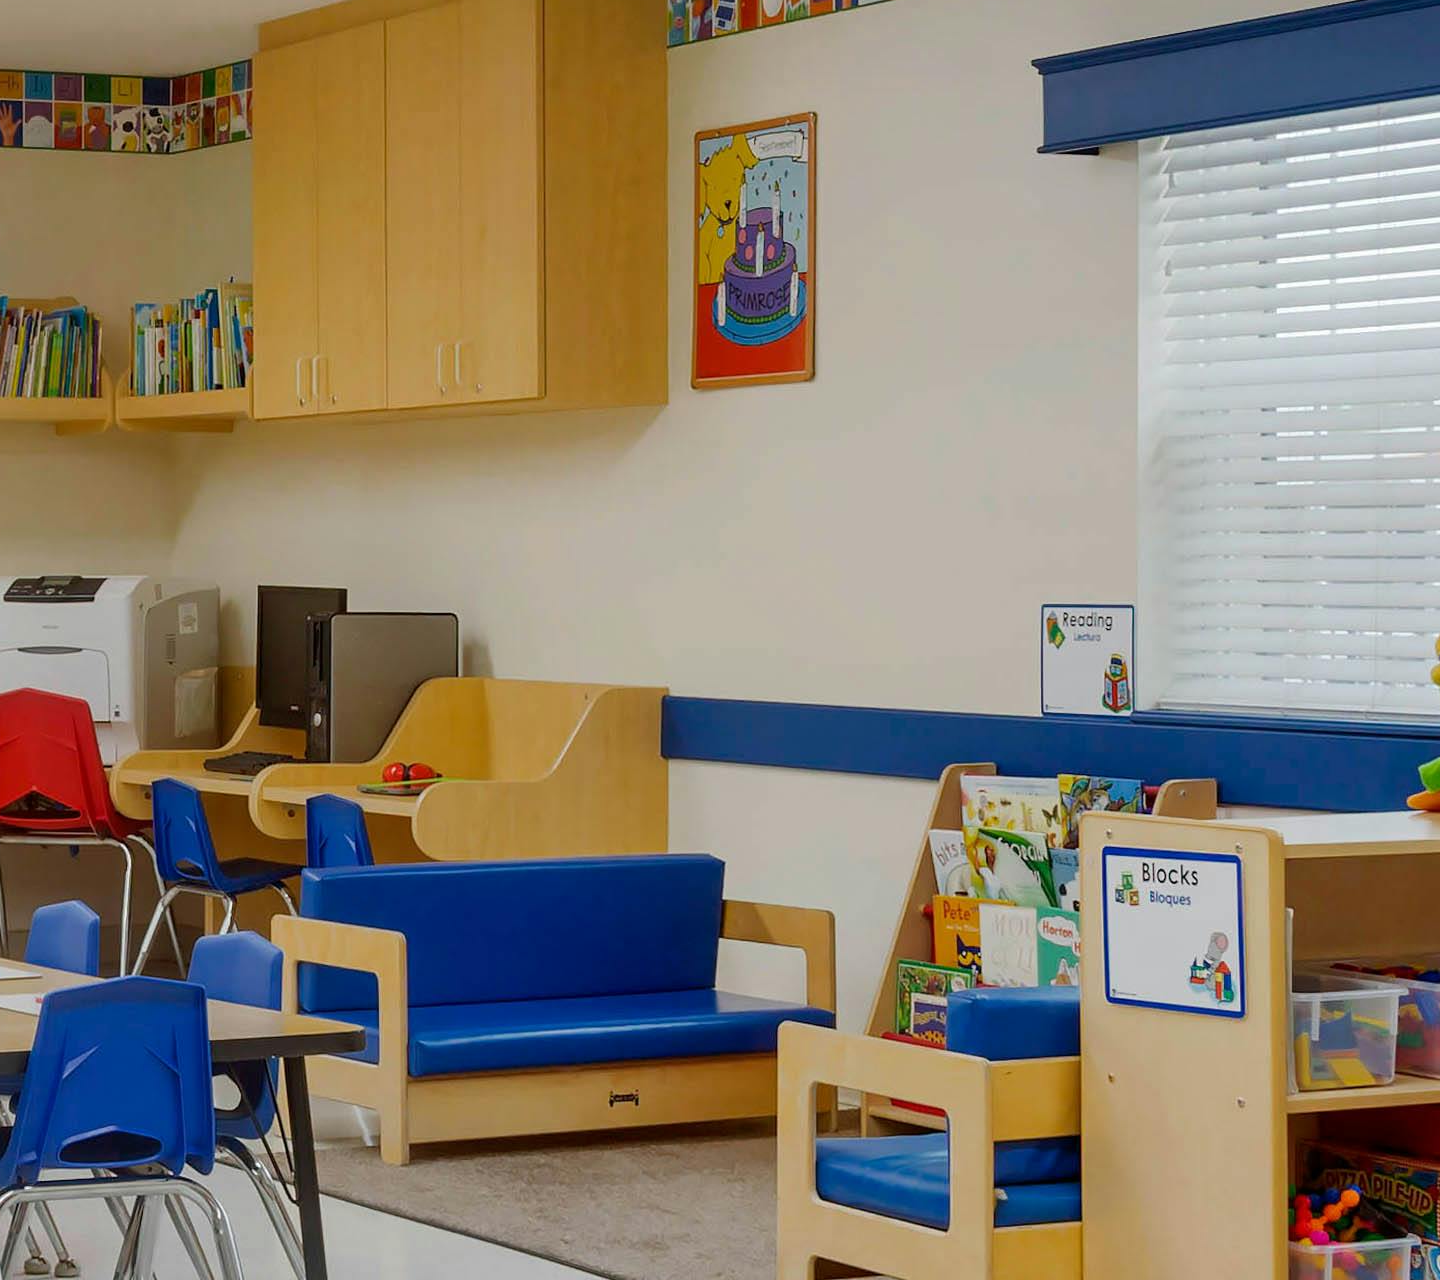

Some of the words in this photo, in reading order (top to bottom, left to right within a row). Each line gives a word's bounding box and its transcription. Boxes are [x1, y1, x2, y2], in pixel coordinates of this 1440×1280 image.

[1062, 611, 1114, 631] Reading
[1141, 861, 1200, 887] Blocks
[1148, 889, 1193, 908] Bloques
[942, 900, 971, 922] Pete
[1042, 922, 1074, 939] Horton
[1371, 1176, 1433, 1215] PILE-UP
